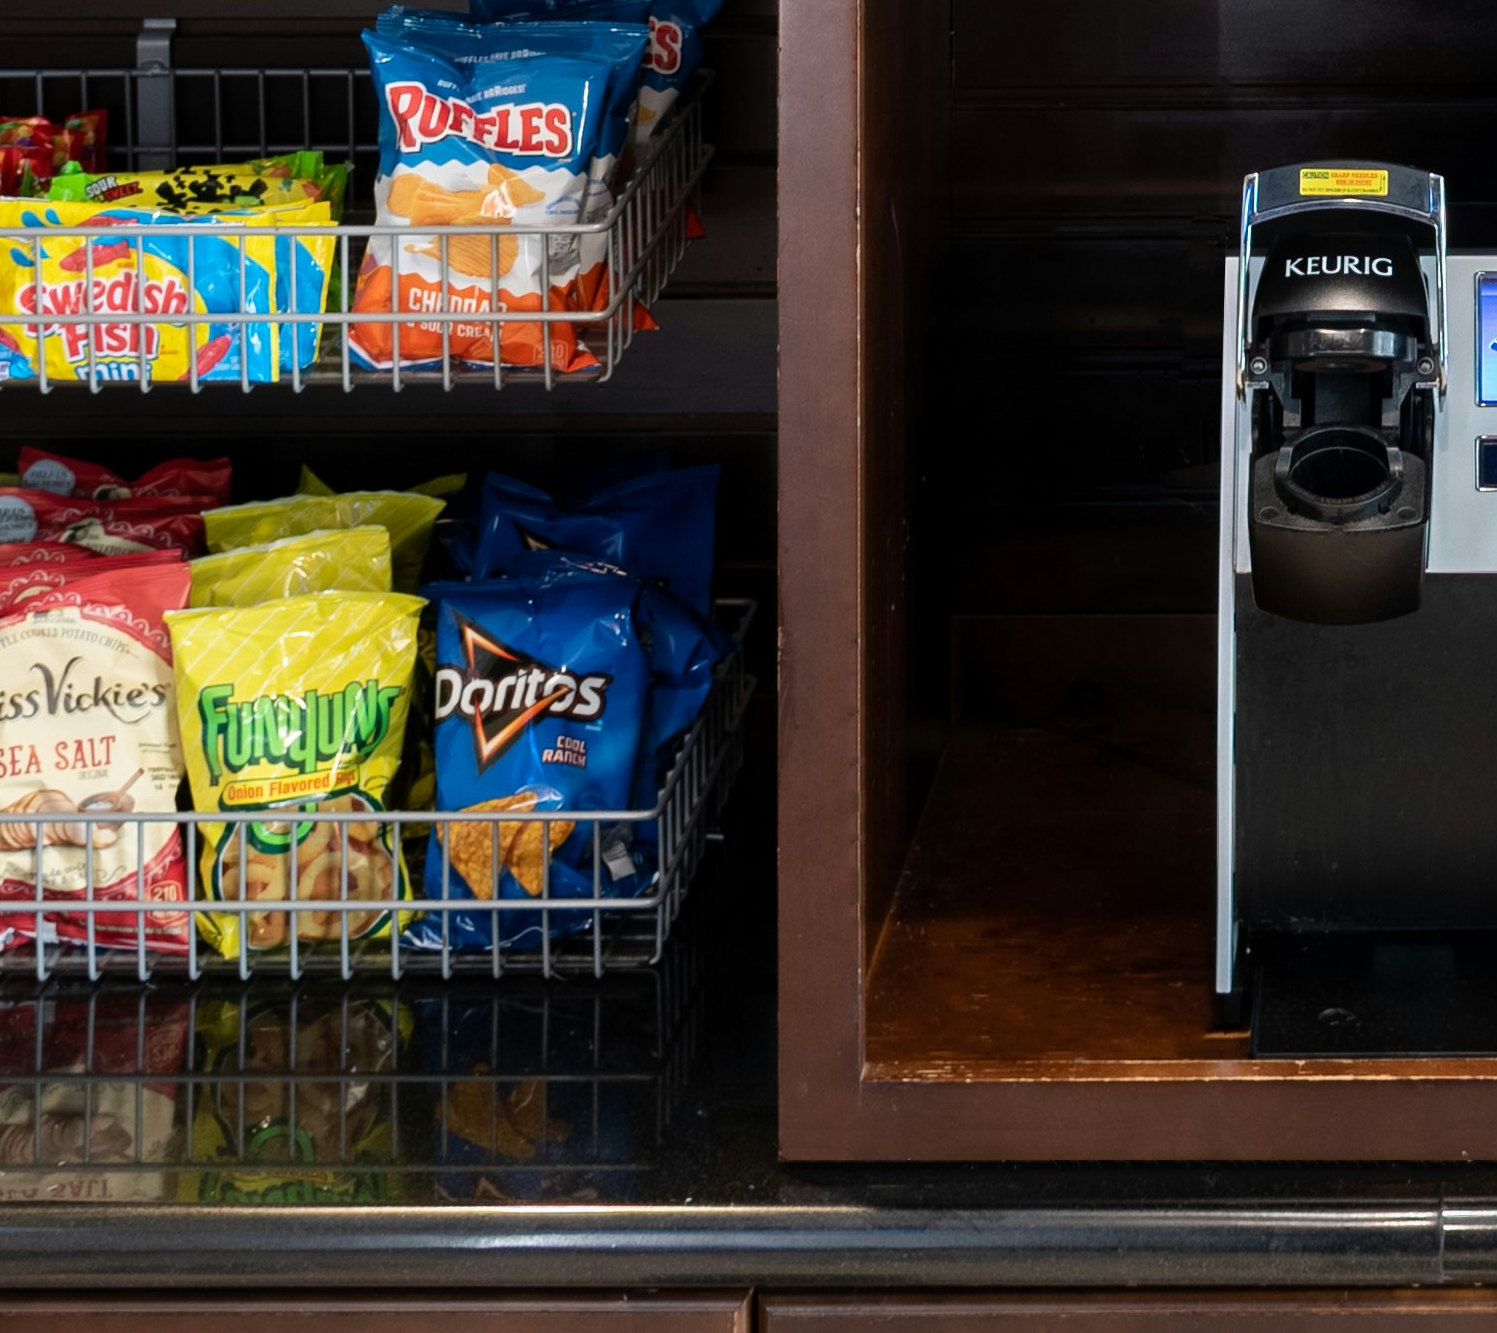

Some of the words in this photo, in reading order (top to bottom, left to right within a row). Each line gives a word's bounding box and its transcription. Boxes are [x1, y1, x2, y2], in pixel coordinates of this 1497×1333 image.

[388, 83, 571, 153] RUFFLES
[1284, 256, 1393, 277] KEURIG
[30, 656, 167, 724] Vickie's
[437, 668, 604, 720] Doritos
[55, 735, 115, 771] SALT
[227, 782, 264, 801] Onion
[267, 774, 330, 799] Flavored
